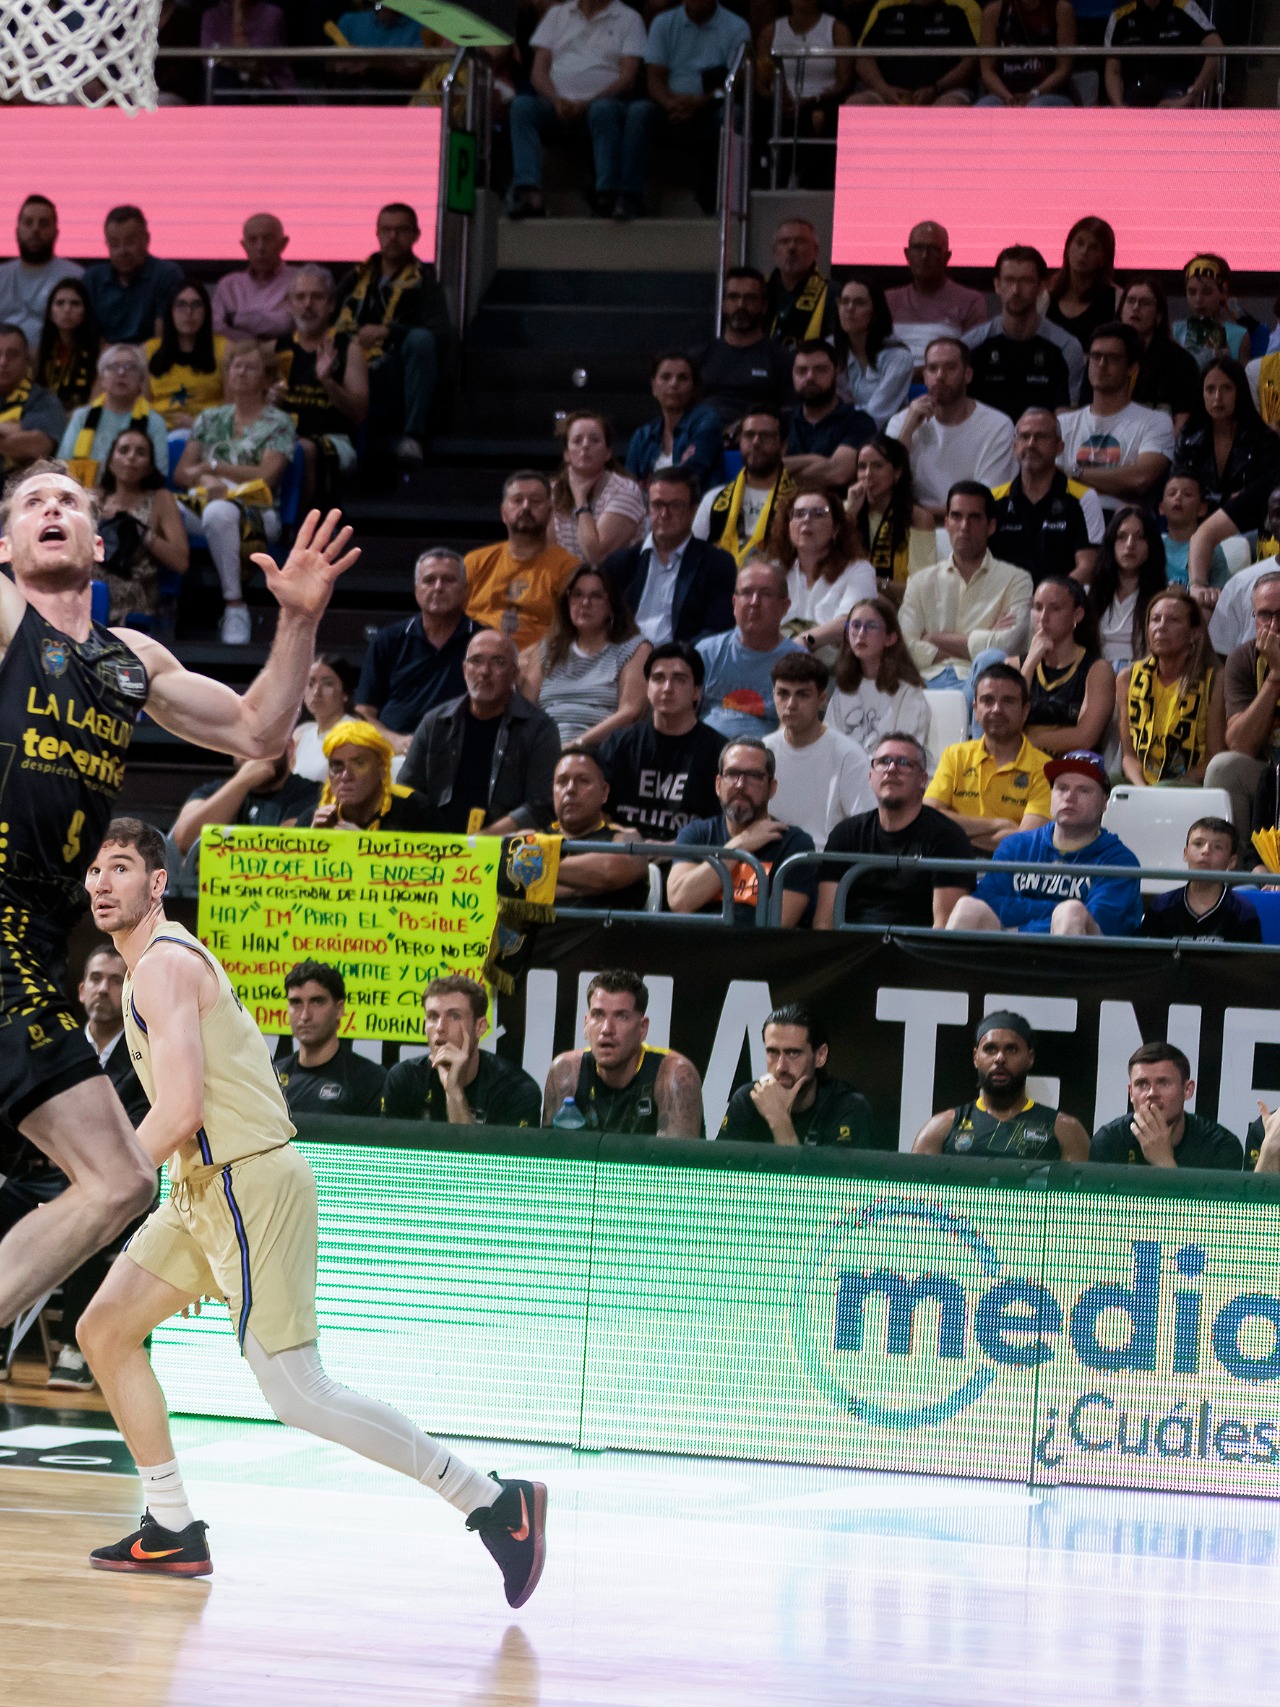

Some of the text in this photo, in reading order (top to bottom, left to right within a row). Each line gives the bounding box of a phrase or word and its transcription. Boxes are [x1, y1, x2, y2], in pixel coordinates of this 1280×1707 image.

[27, 686, 134, 749] LA LAGUN
[358, 837, 464, 863] Aurinegro
[274, 859, 305, 876] OFF
[370, 863, 445, 884] ENDESA
[234, 885, 263, 898] SAN
[335, 888, 356, 901] DE
[360, 887, 378, 904] LA
[452, 890, 479, 910] NO
[304, 907, 347, 928] PARA
[359, 911, 384, 929] EL
[212, 929, 231, 950] TE
[242, 932, 279, 953] HAN
[395, 938, 435, 957] PERO
